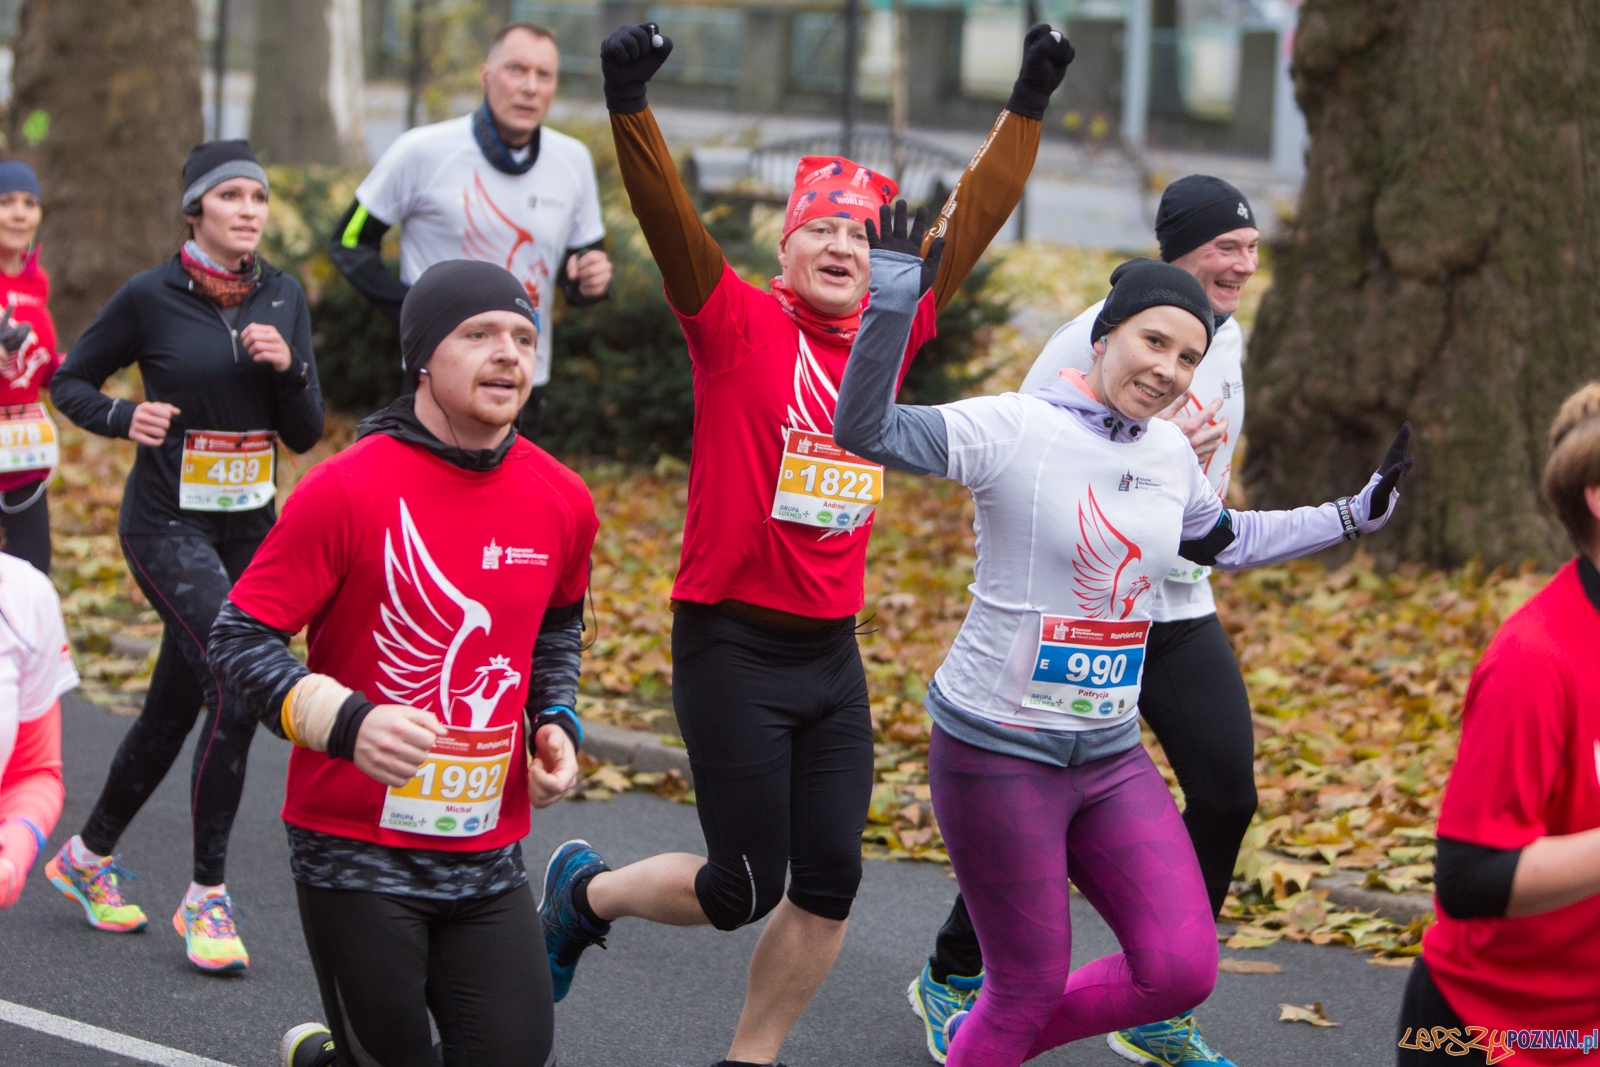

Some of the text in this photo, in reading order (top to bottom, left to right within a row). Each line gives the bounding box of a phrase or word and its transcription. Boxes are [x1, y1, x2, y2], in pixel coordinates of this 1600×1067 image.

[836, 196, 864, 207] WORLD
[206, 458, 260, 484] 489
[784, 469, 794, 479] D
[800, 464, 874, 501] 1822
[779, 505, 799, 513] GRUPA
[823, 501, 846, 511] Andrzej
[778, 511, 802, 519] LUXMED
[1110, 631, 1143, 640] RunPoland.org
[1039, 659, 1050, 669] E
[1065, 652, 1128, 686] 990
[1078, 689, 1109, 700] Patrycja
[415, 761, 503, 800] 1992
[445, 805, 472, 813] Michal
[390, 812, 414, 820] GRUPA
[389, 819, 417, 828] LUXMED
